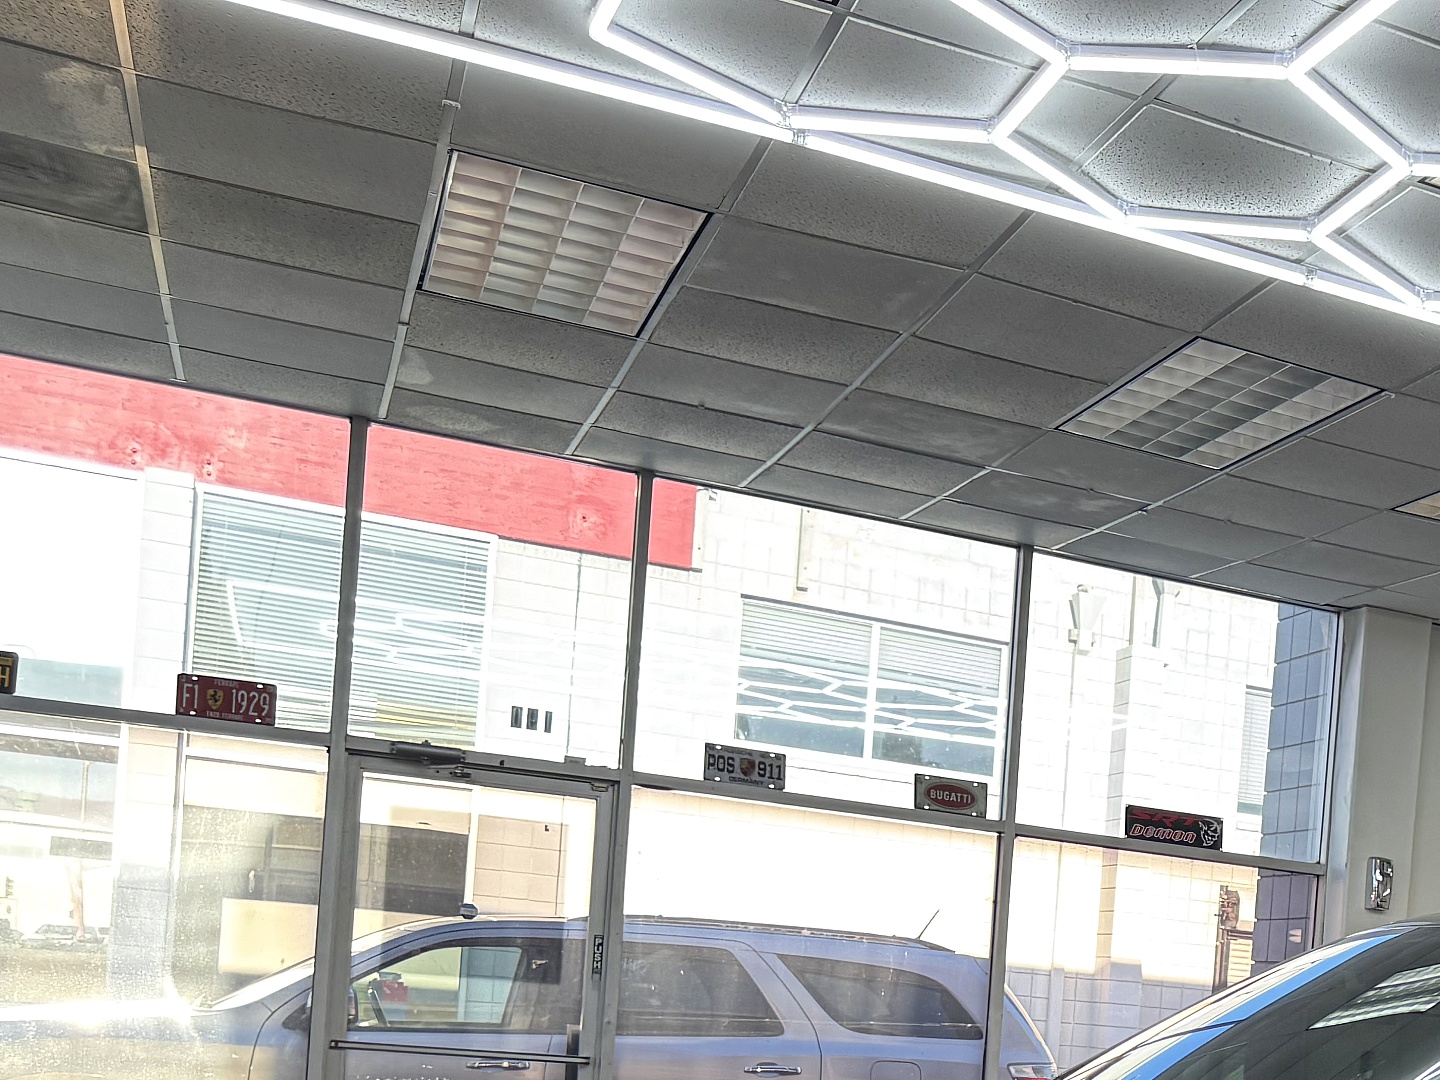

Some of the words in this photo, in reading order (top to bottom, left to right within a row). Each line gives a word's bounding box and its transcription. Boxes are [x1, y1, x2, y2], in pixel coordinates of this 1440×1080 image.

[183, 683, 199, 709] F1
[231, 689, 270, 717] 1929
[757, 760, 784, 782] 911
[930, 789, 971, 804] BUGATTI
[1129, 808, 1205, 828] SRT
[593, 937, 603, 969] PUSH
